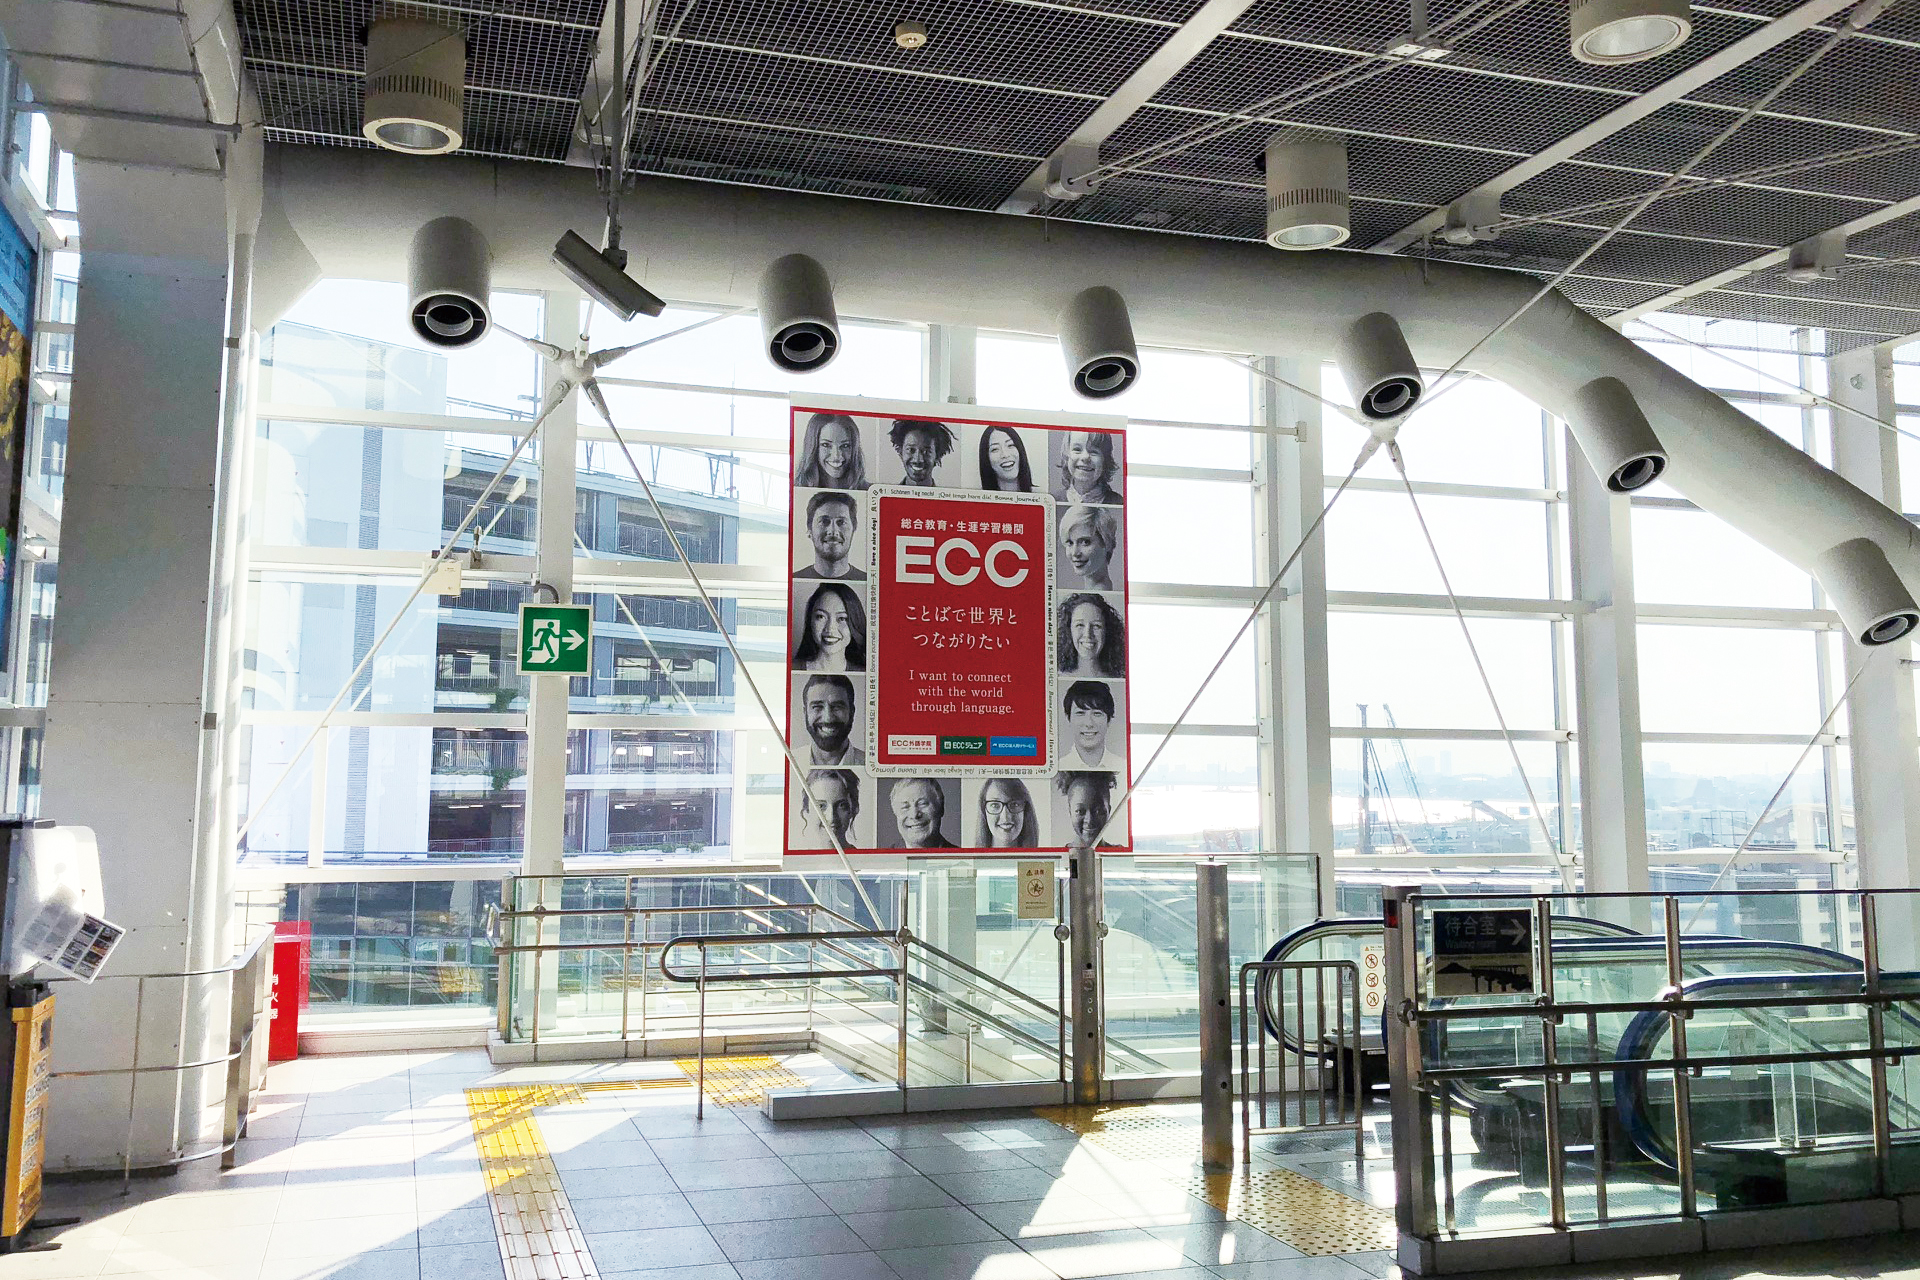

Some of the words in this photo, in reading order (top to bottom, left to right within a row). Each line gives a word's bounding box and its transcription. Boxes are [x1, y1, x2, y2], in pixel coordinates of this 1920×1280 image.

[900, 518, 1024, 535] 総合教育・生涯学習機関
[896, 535, 1029, 588] ECC
[906, 605, 1018, 625] ことばで世界と
[913, 632, 1010, 650] つながりたい
[909, 670, 914, 680] I
[919, 672, 947, 681] want
[952, 672, 963, 681] to
[968, 673, 1012, 683] connect
[918, 686, 943, 696] with
[948, 686, 966, 697] the
[971, 687, 1004, 698] world
[911, 701, 956, 714] through
[961, 702, 1015, 715] language.
[1445, 915, 1497, 936] 待合室
